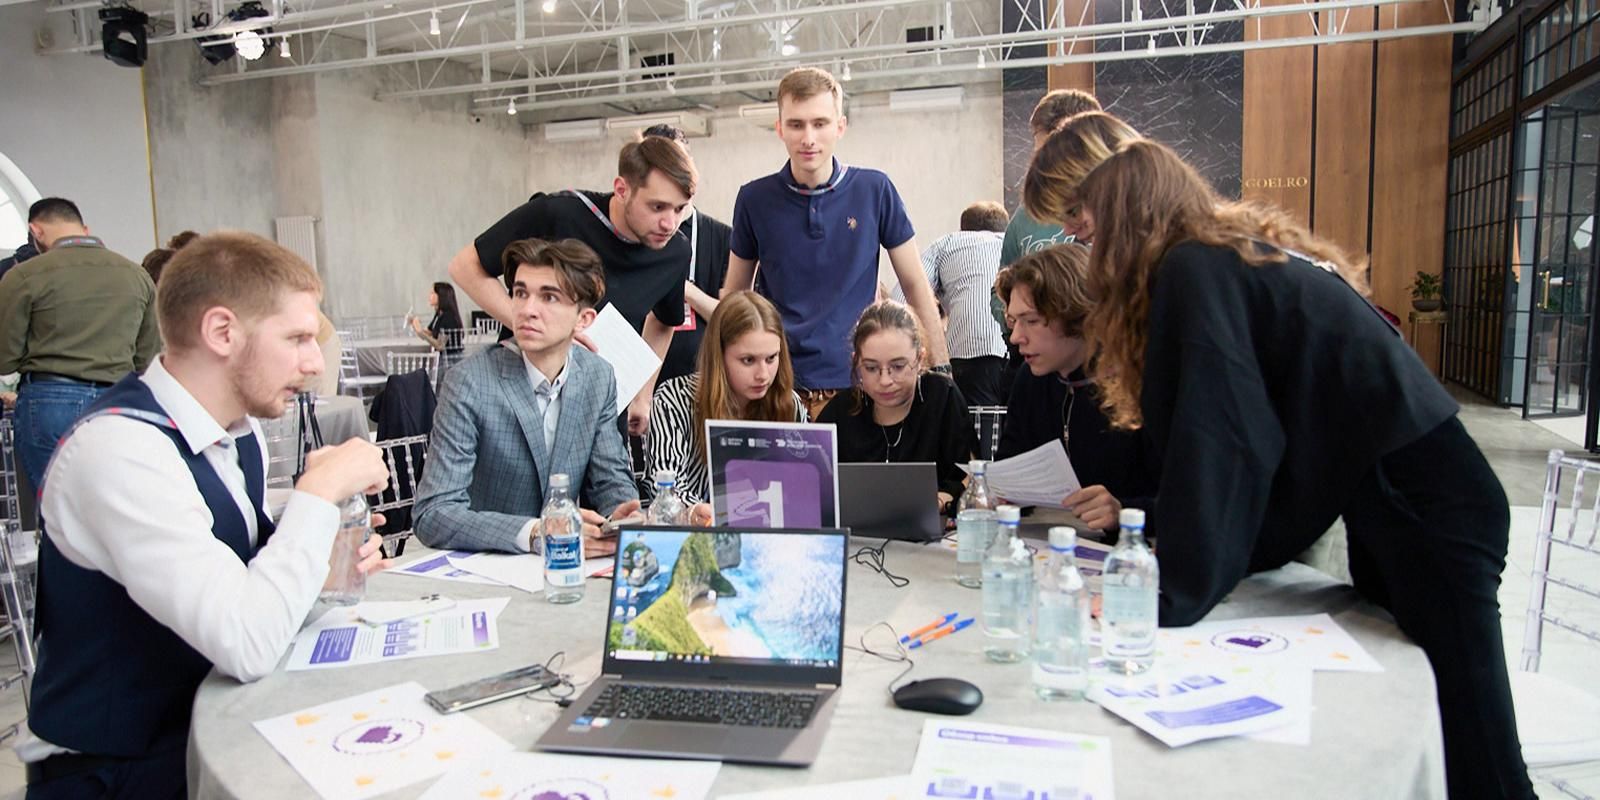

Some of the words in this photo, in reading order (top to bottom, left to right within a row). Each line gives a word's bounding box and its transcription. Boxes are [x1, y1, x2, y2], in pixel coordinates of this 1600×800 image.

[1245, 176, 1308, 189] GOELRO
[758, 480, 784, 528] 1
[551, 550, 576, 561] Baikal
